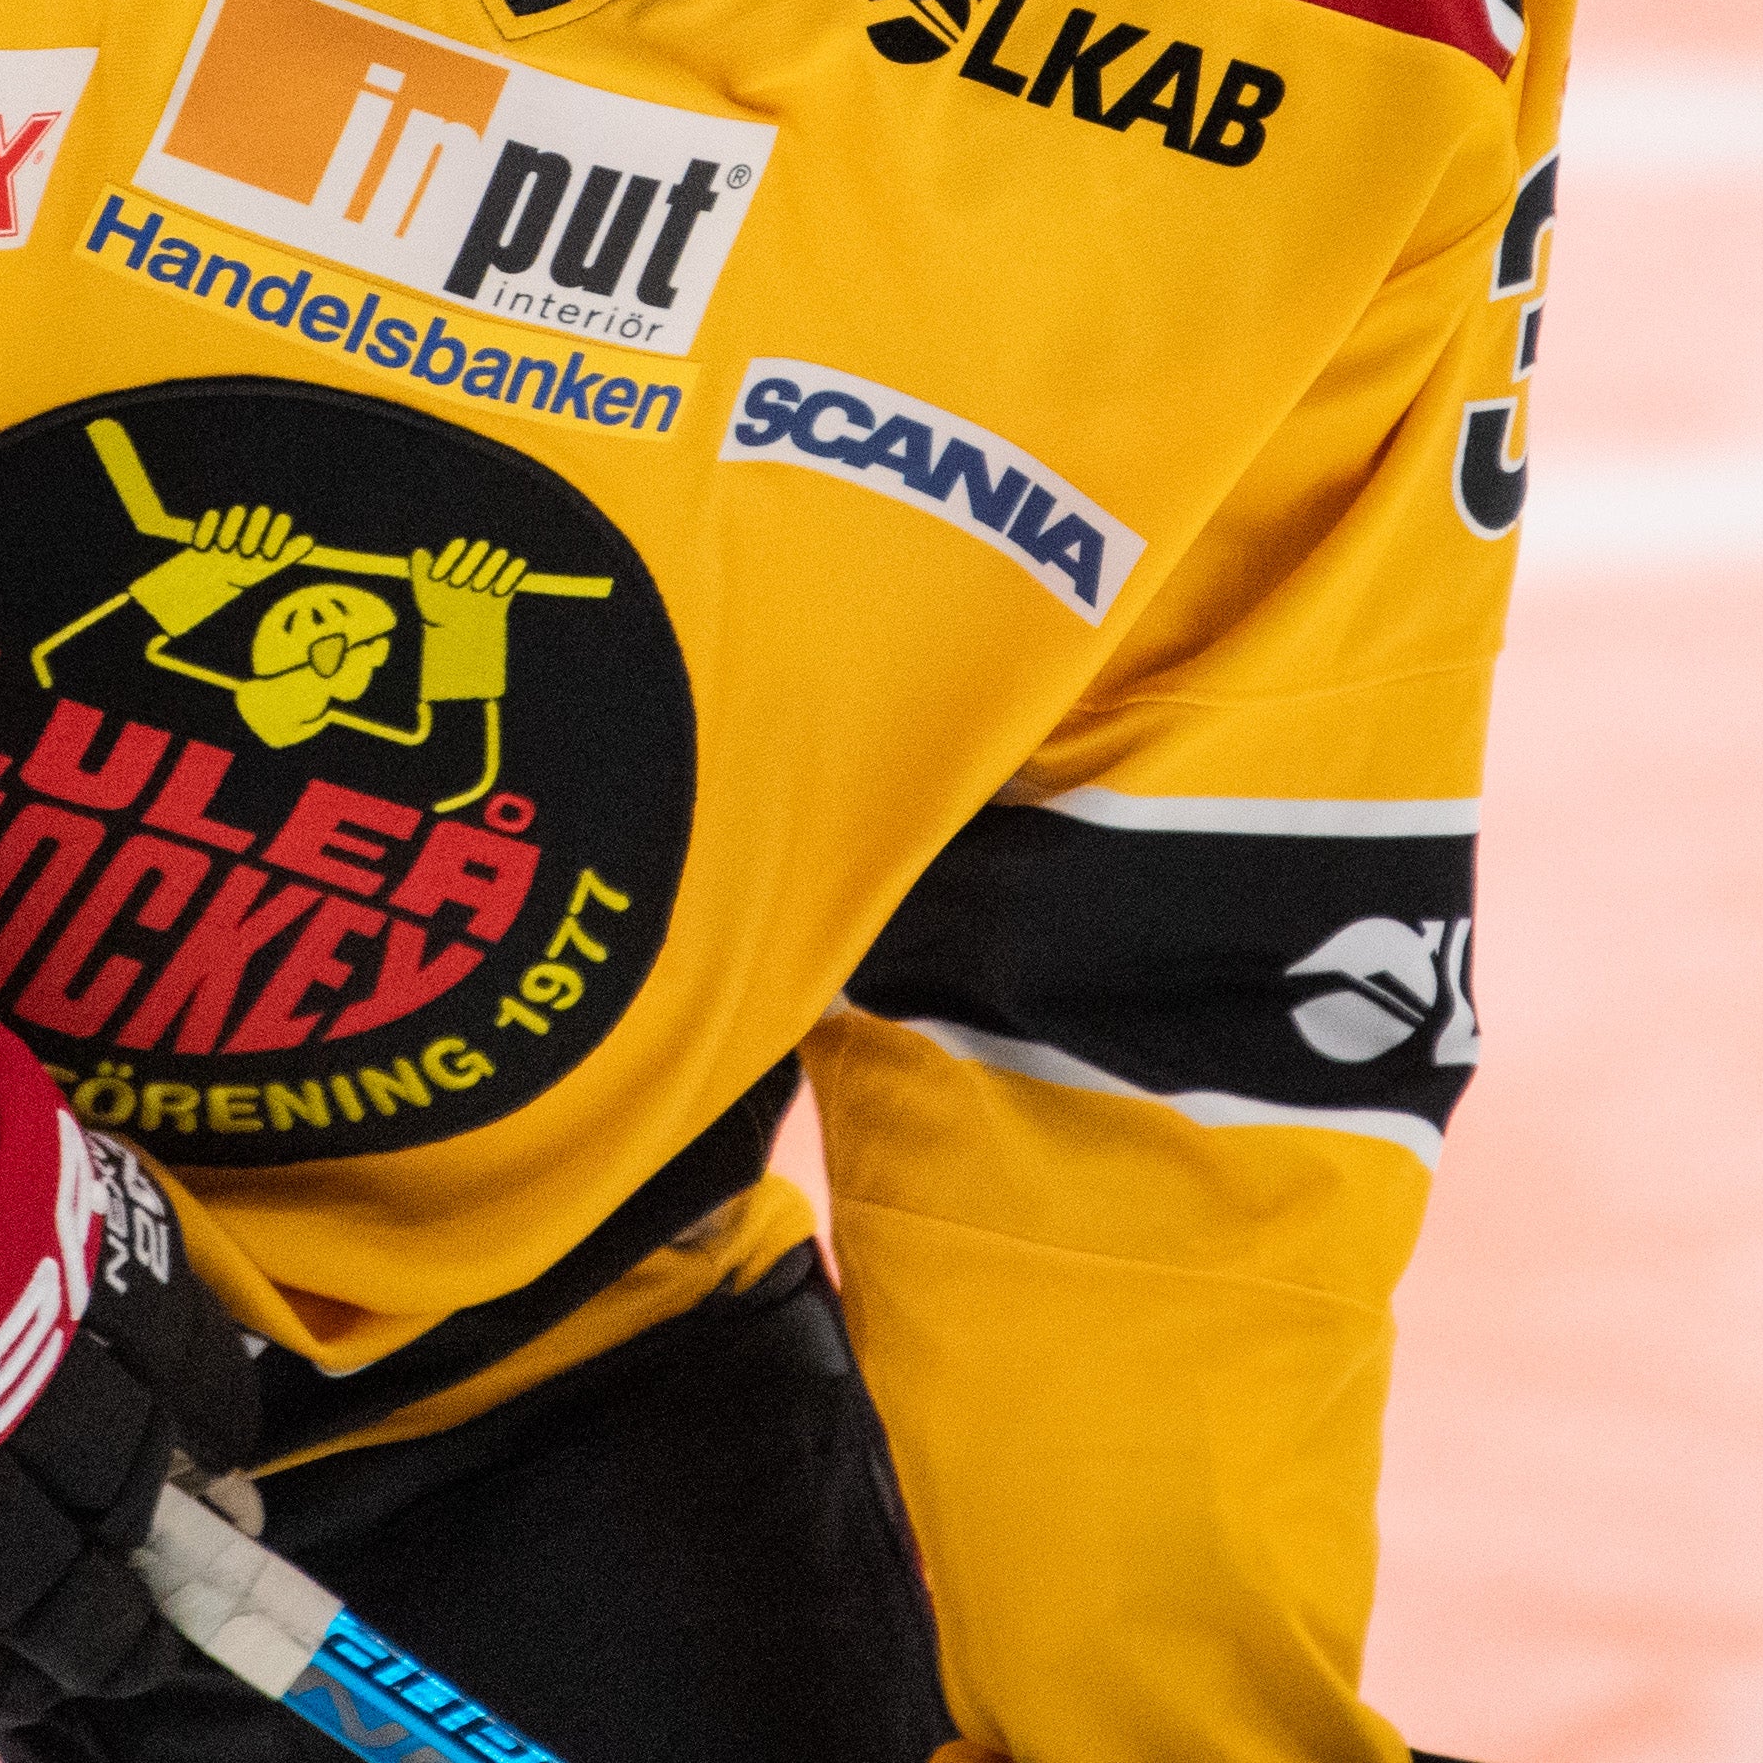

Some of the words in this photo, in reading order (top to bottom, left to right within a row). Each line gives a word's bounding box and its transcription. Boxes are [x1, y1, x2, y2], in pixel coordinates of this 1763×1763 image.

[84, 196, 683, 434] Handelsbanken
[492, 279, 665, 342] interiör
[735, 376, 1107, 609] SCANIA
[42, 1036, 496, 1135] ÖRENING
[494, 866, 631, 1037] 1977
